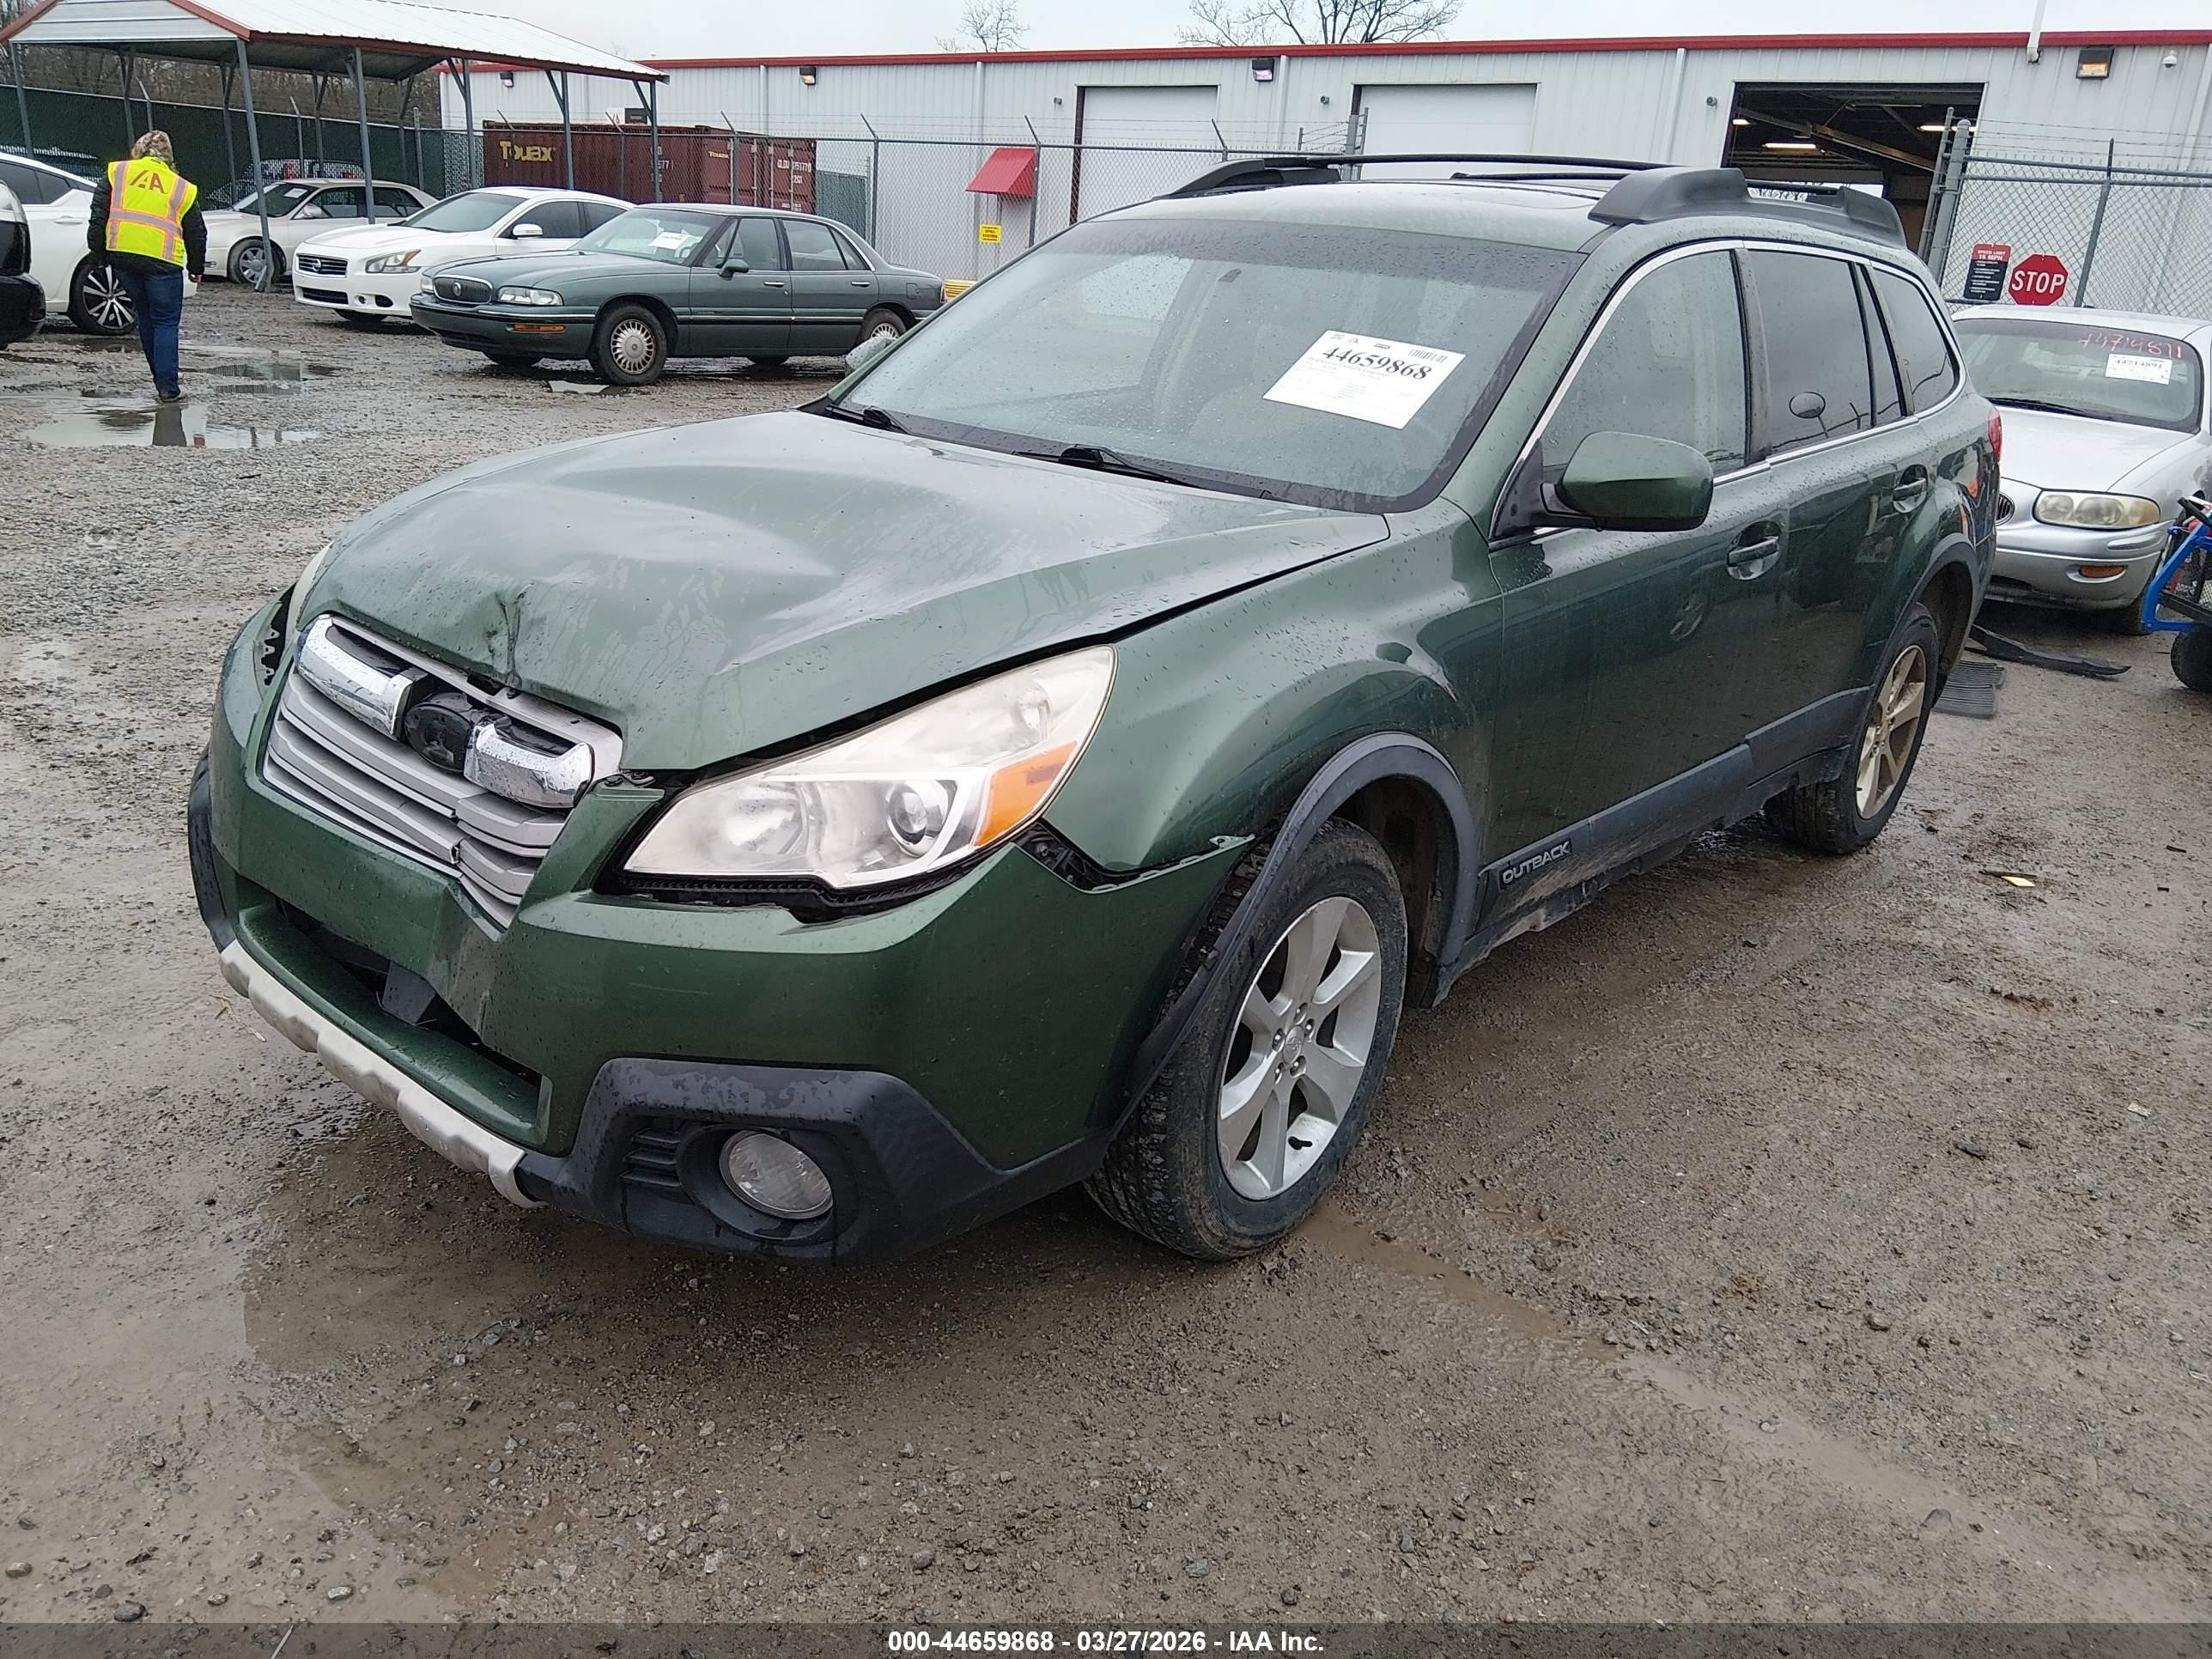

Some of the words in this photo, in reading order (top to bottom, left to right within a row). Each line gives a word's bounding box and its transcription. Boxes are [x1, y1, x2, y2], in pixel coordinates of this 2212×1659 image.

[2011, 270, 2065, 295] STOP
[1322, 346, 1432, 380] 44659868
[1503, 841, 1570, 884] OUTBACK
